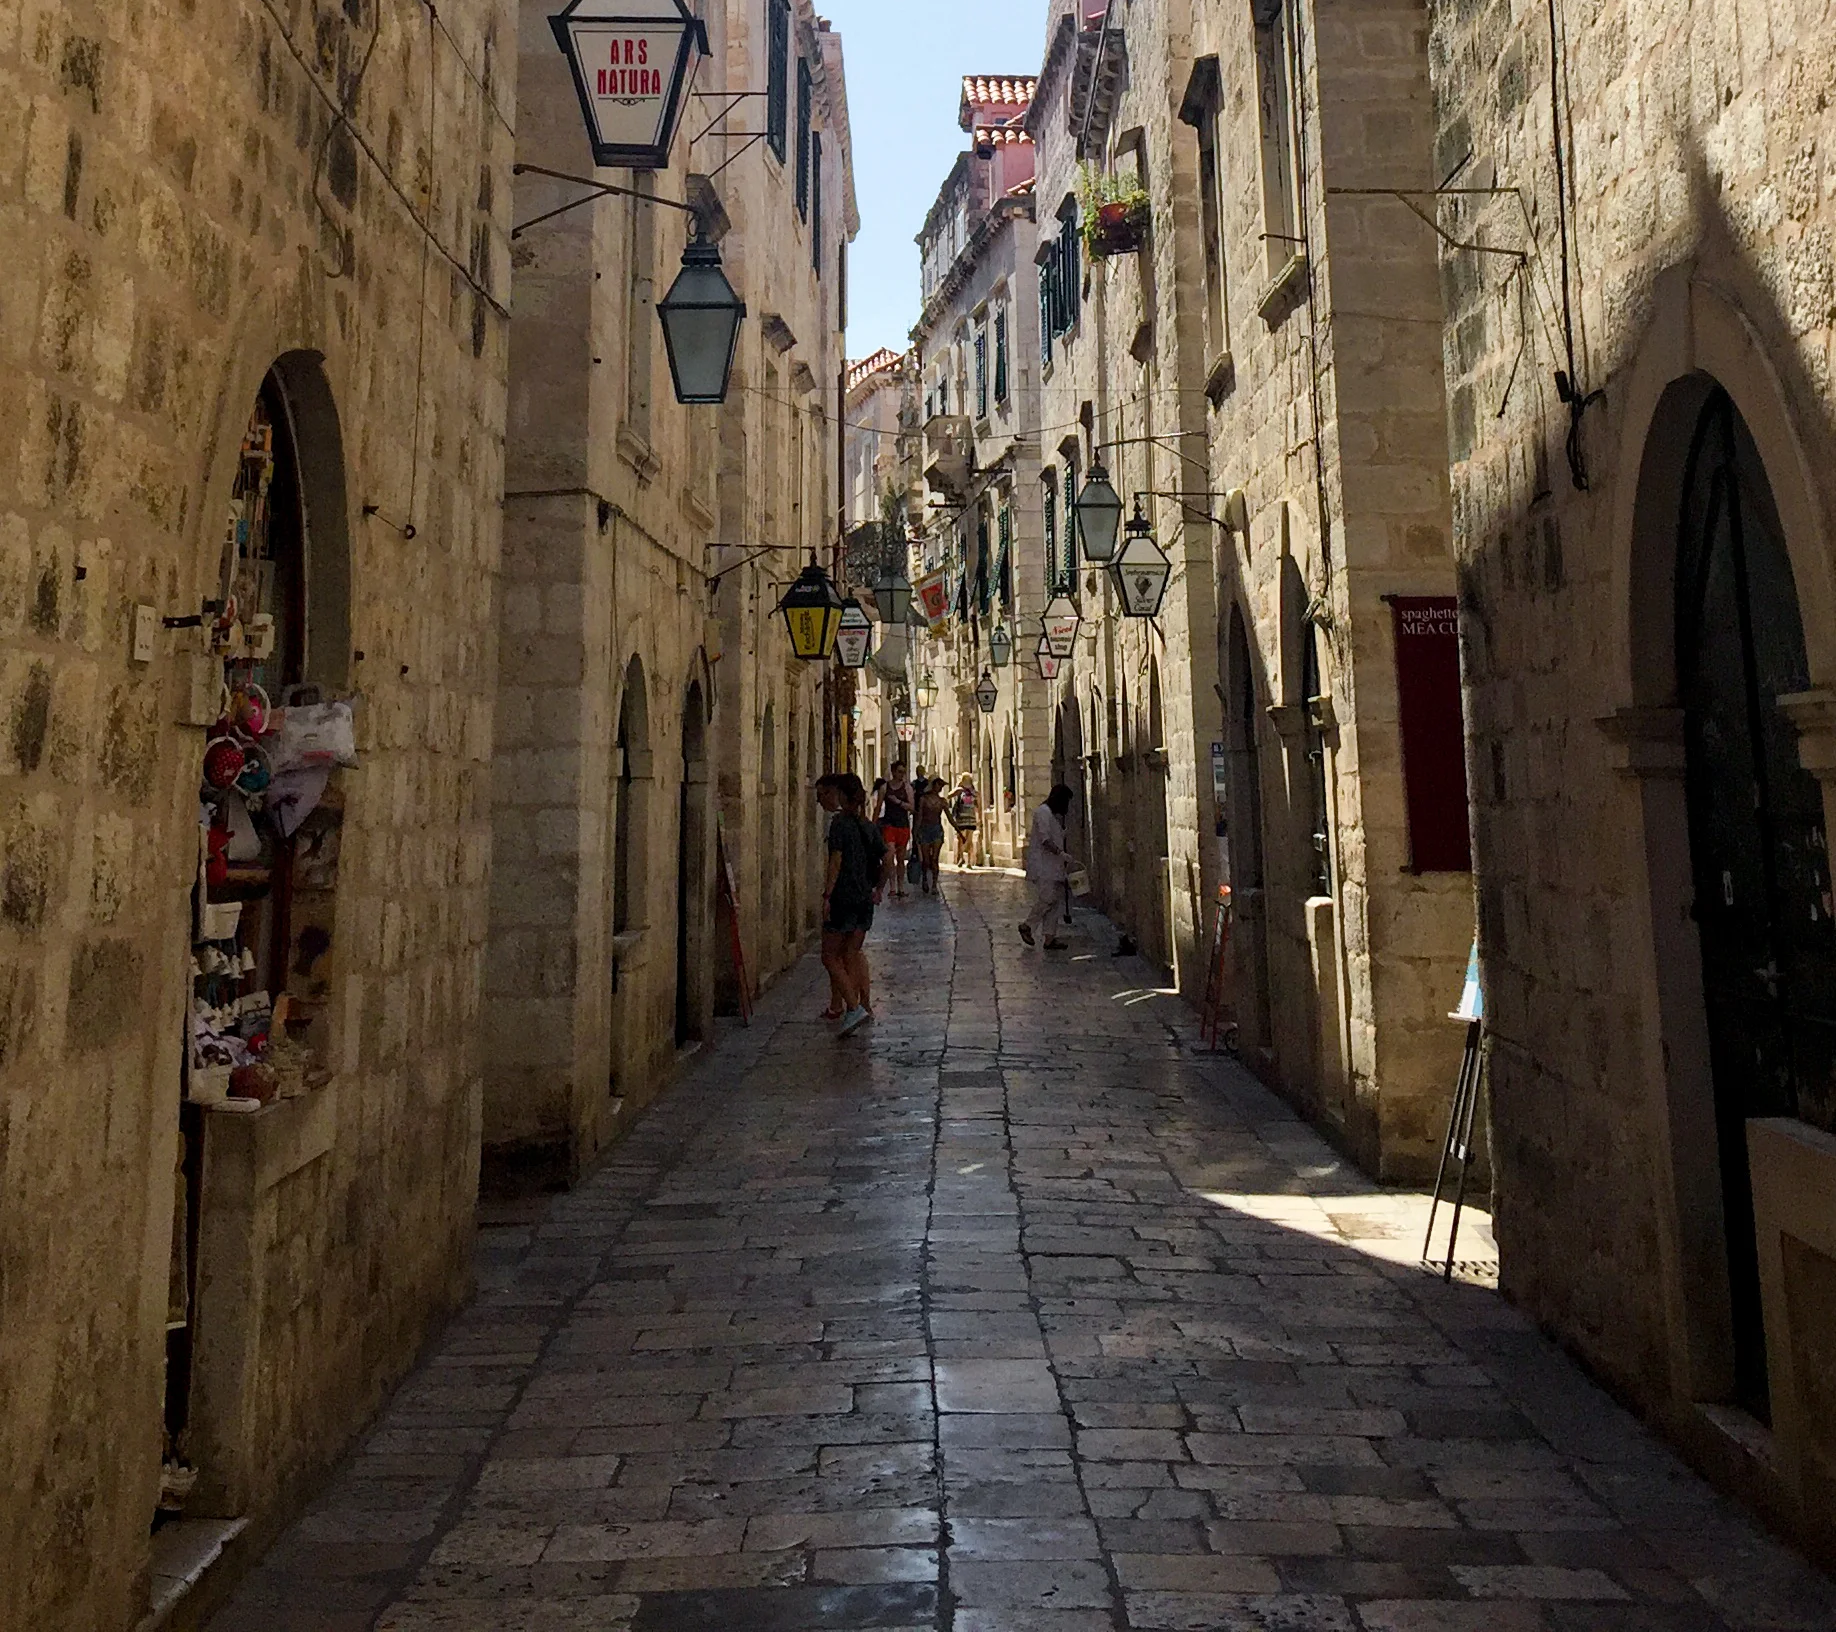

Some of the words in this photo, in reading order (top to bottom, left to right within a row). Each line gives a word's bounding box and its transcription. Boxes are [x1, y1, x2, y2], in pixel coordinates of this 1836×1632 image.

[610, 38, 648, 65] ARS
[597, 69, 661, 95] NATURA
[1402, 622, 1437, 635] MEA
